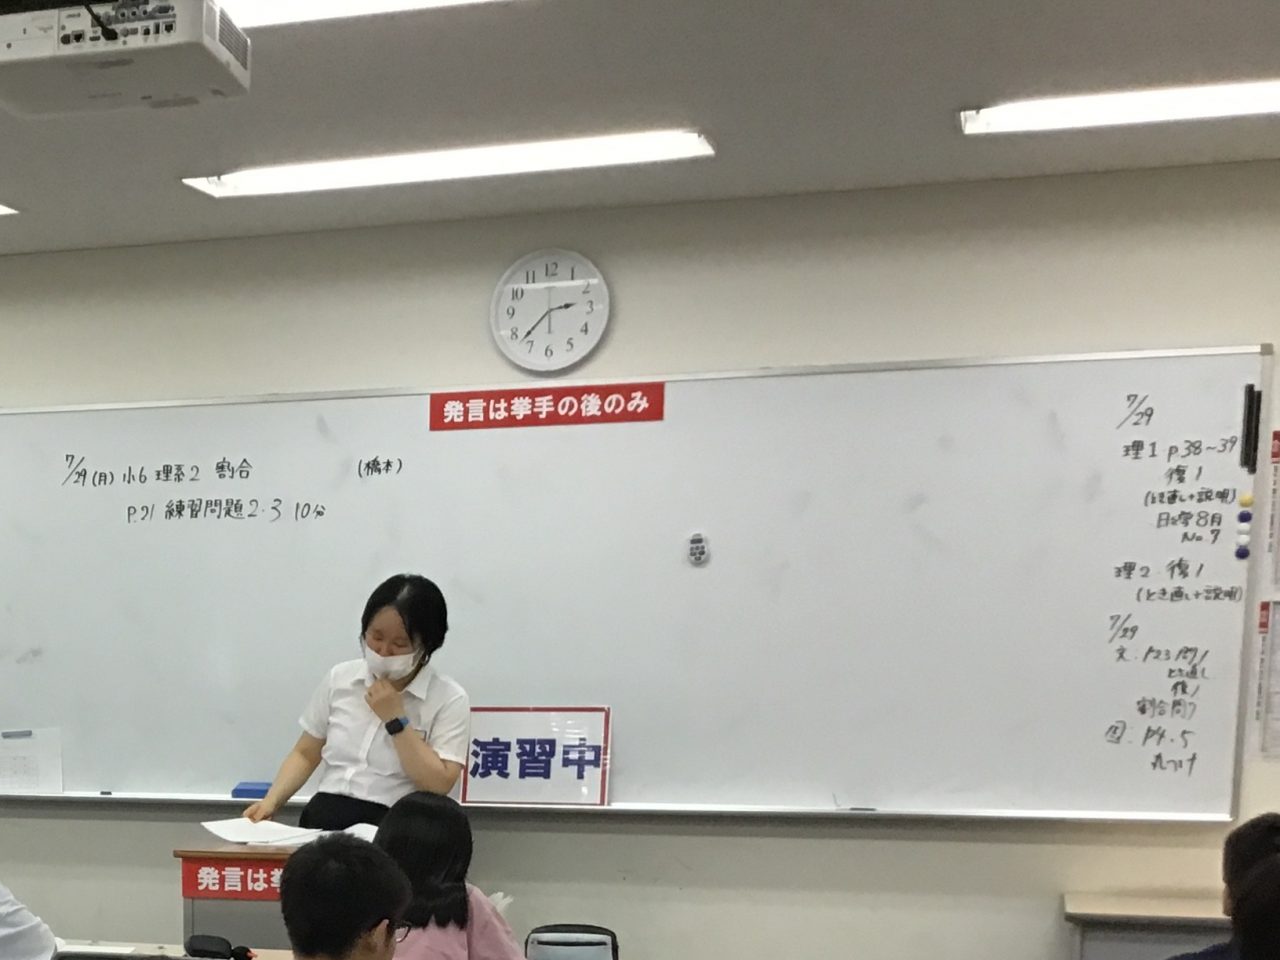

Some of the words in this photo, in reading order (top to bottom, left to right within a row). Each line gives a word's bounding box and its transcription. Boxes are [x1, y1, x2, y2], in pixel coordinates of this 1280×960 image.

[545, 262, 558, 276] 12
[570, 266, 575, 280] 1
[525, 270, 535, 284] 11
[582, 278, 590, 294] 2
[512, 287, 524, 300] 10
[506, 305, 515, 319] 9
[586, 300, 594, 315] 3
[510, 327, 518, 340] 8
[580, 322, 588, 335] 4
[525, 340, 534, 353] 7
[544, 345, 553, 357] 6
[566, 337, 574, 352] 5
[443, 391, 649, 423] 発言は挙手の後のみ
[1116, 394, 1154, 429] 7/29
[215, 457, 253, 479] 割合
[470, 737, 601, 780] 演習中
